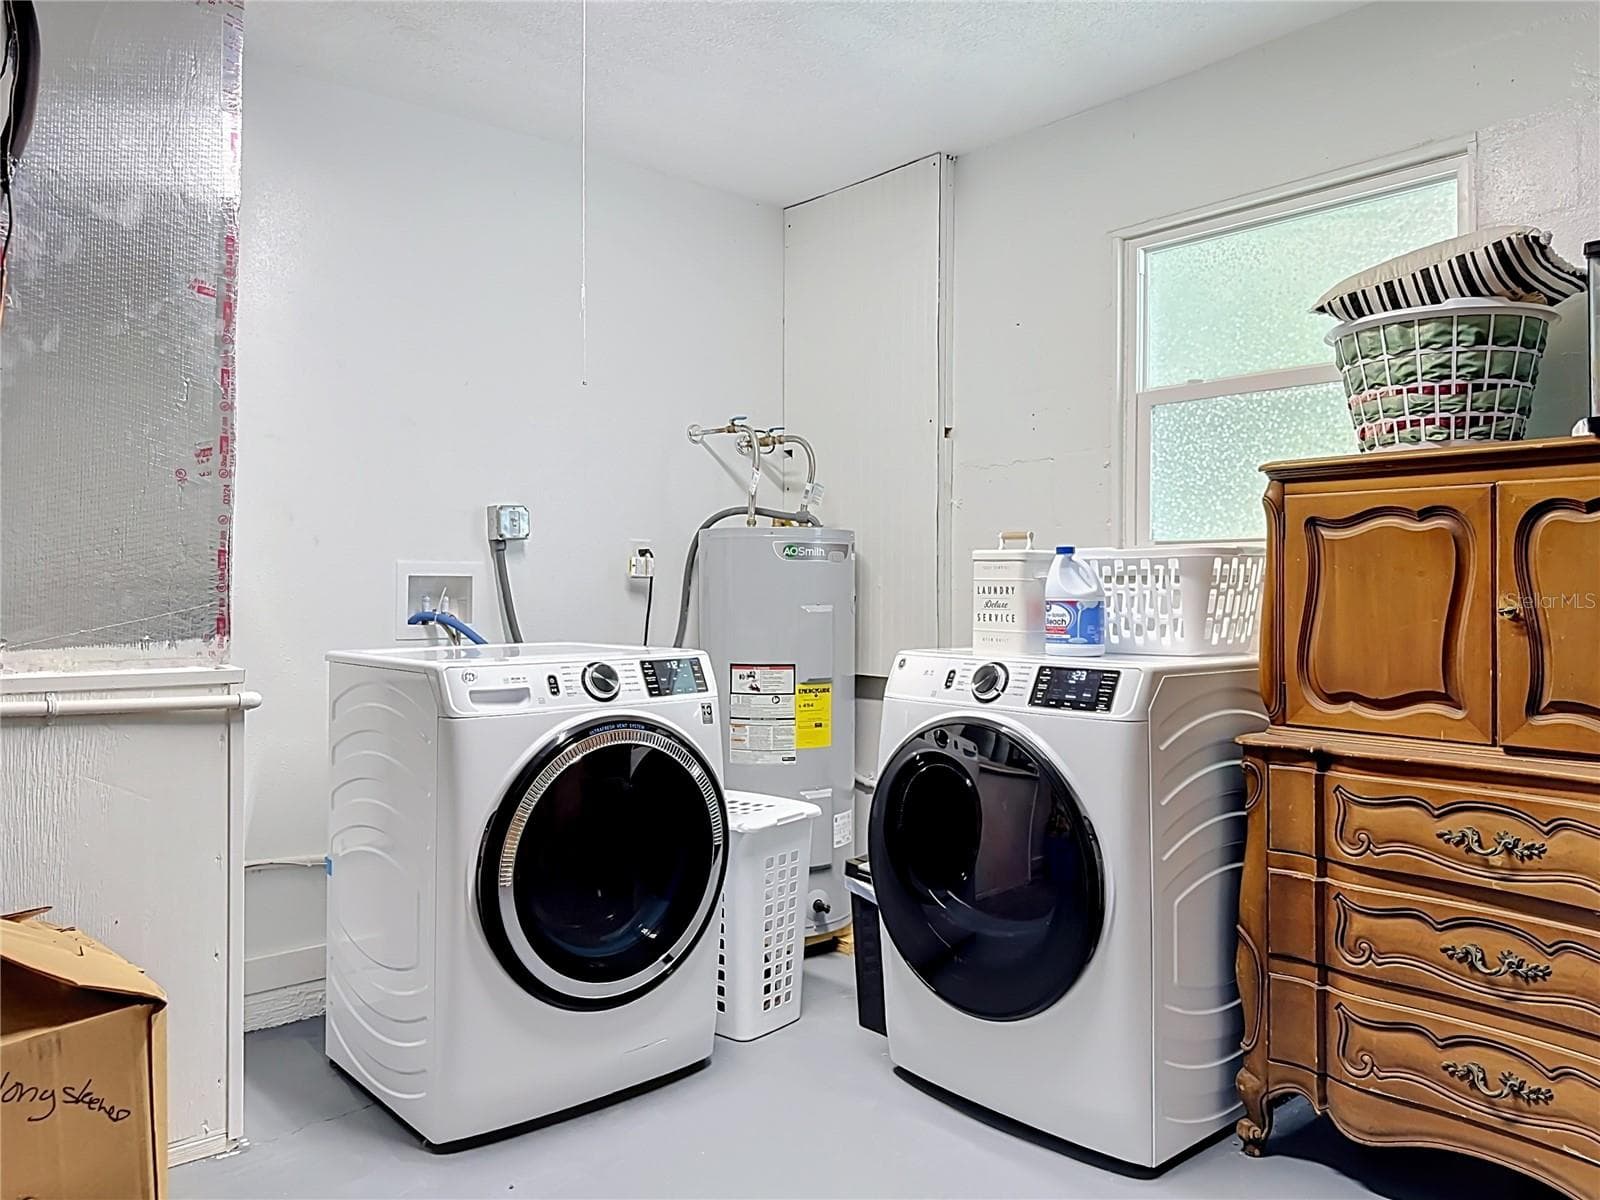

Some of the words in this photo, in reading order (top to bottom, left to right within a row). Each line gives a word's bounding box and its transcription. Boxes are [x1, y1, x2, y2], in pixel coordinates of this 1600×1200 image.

[977, 586, 1015, 595] LAUNDRY
[984, 599, 1009, 609] Deluxe
[977, 613, 1015, 623] SERVICE
